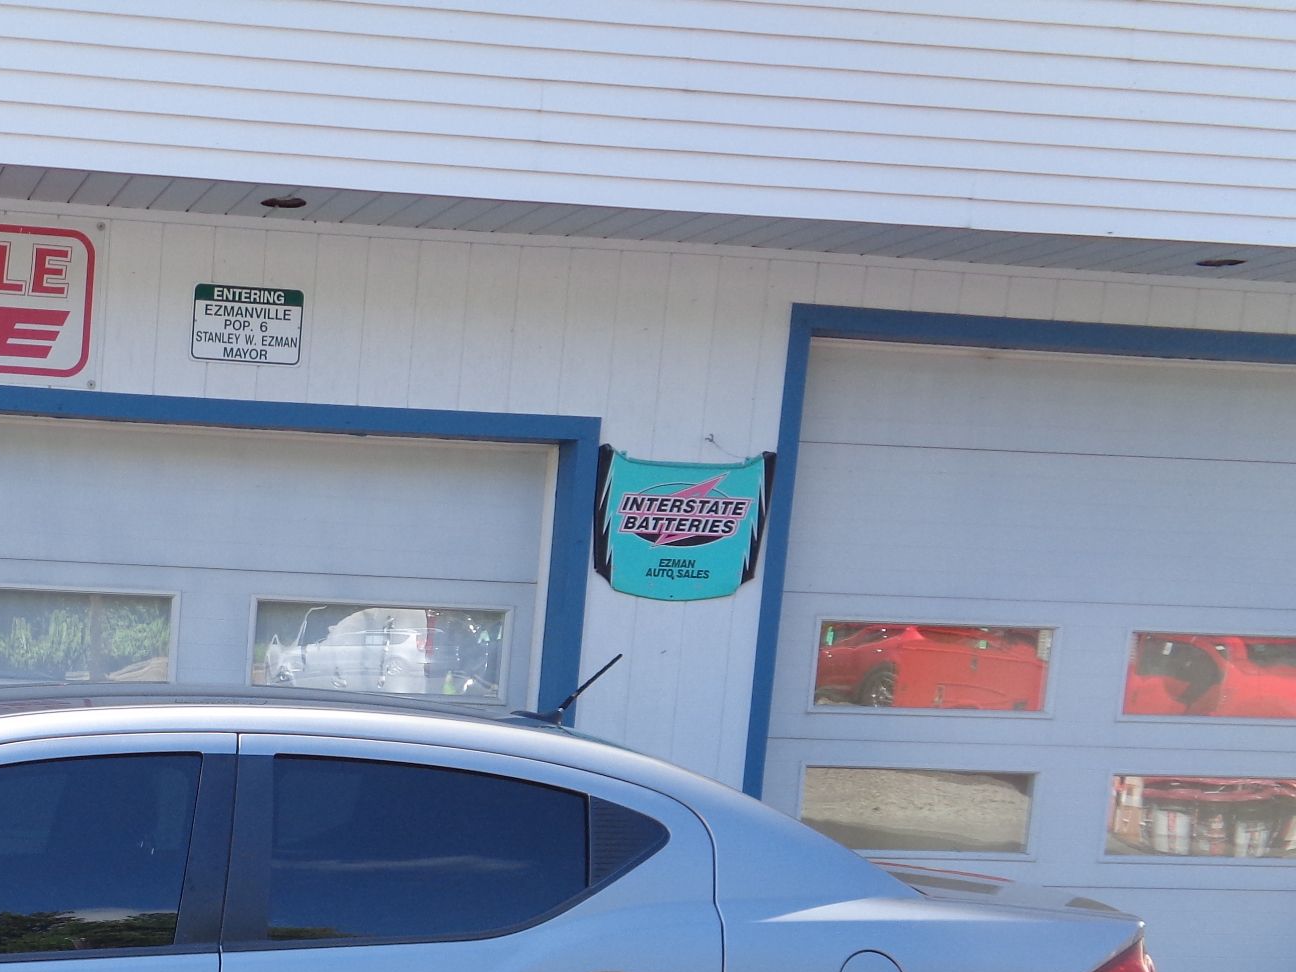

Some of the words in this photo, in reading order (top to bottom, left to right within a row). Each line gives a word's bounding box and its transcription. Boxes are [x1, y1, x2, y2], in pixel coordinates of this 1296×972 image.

[213, 287, 285, 304] ENTERING
[204, 304, 292, 321] EZMANVILLE
[224, 319, 253, 332] POP.
[260, 321, 268, 332] 6
[195, 331, 240, 345] STANLEY
[245, 334, 257, 346] W.
[261, 335, 298, 348] EZMAN
[223, 347, 268, 360] MAYOR
[621, 496, 747, 517] INTERSTATE
[623, 515, 737, 535] BATTERIES
[658, 558, 696, 569] EZMAN
[645, 568, 675, 579] AUTO
[676, 569, 710, 579] SALES
